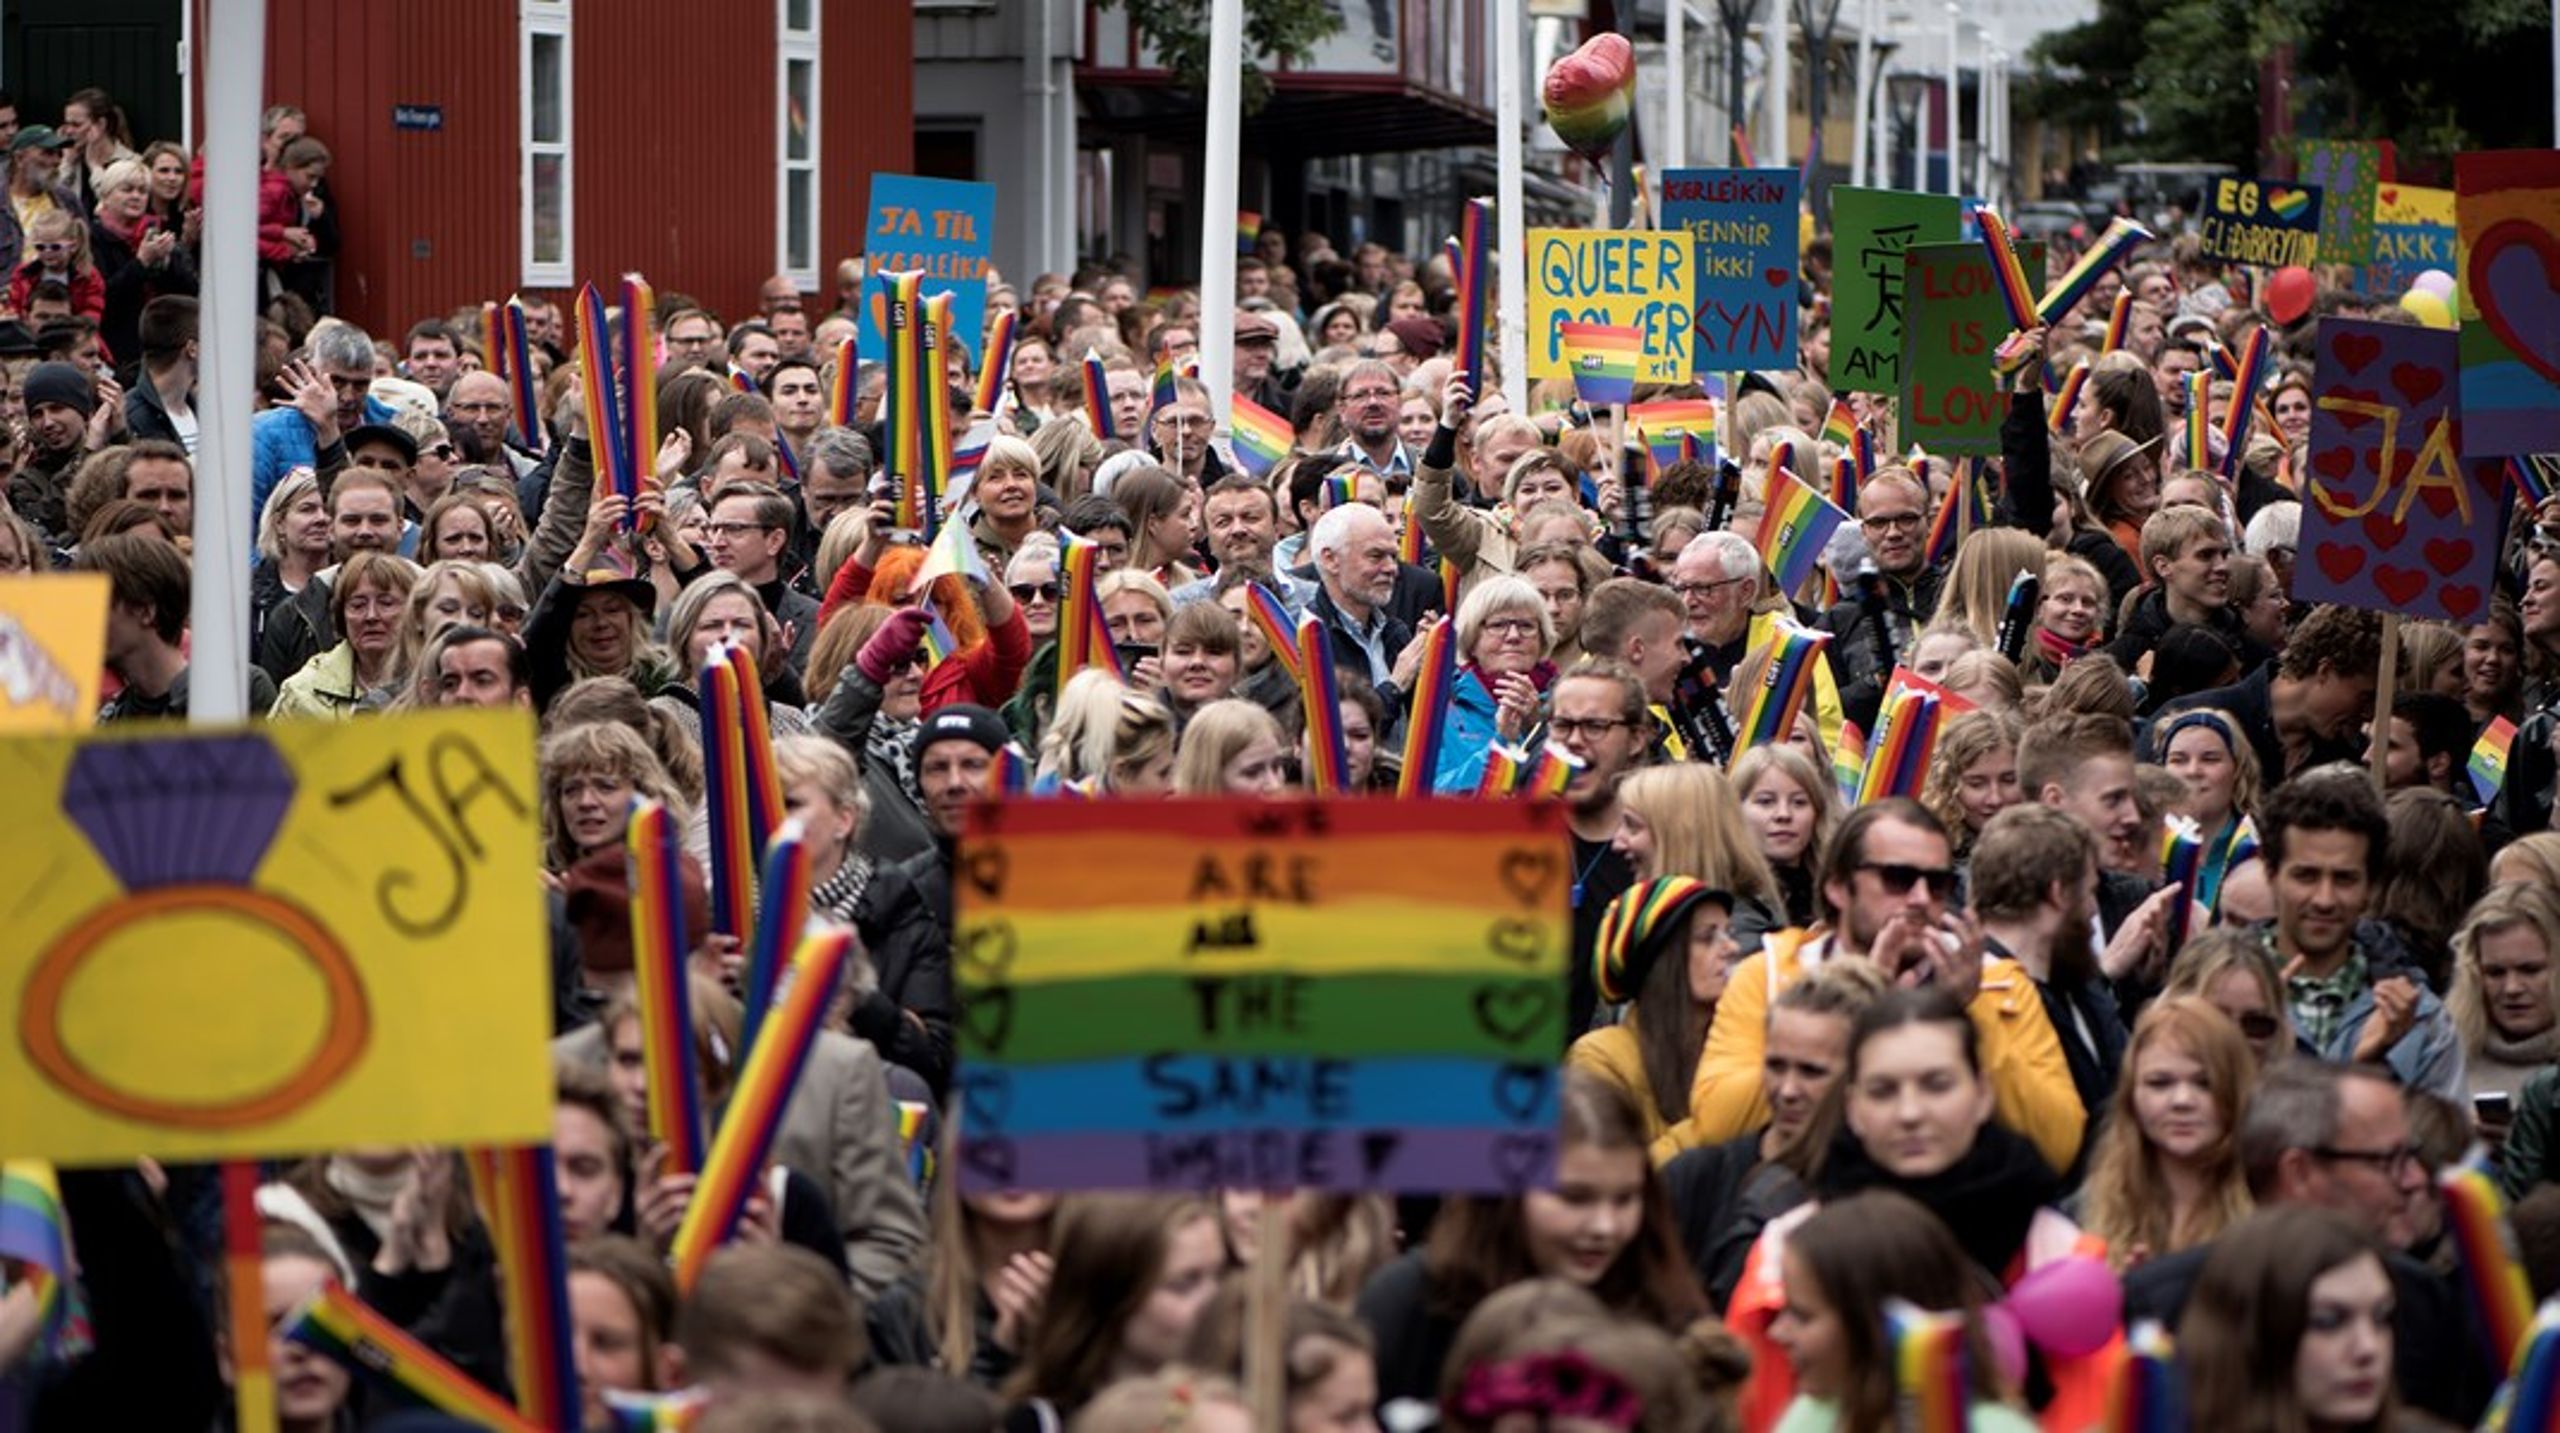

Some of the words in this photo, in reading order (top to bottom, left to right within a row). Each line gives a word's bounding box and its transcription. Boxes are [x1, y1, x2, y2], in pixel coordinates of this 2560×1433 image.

[2217, 179, 2259, 217] EG
[877, 207, 922, 236] JA
[933, 210, 977, 242] TIL
[2373, 229, 2438, 262] AKK
[1541, 238, 1684, 298] QUEER
[1924, 263, 1998, 299] LOV
[1694, 298, 1787, 355] KYN
[1951, 321, 1986, 357] IS
[1844, 346, 1899, 385] AM
[2310, 396, 2475, 527] JA
[327, 731, 530, 939] JA
[1190, 854, 1323, 904] ARE
[1189, 976, 1314, 1035] THE
[1143, 1052, 1355, 1118] SAME
